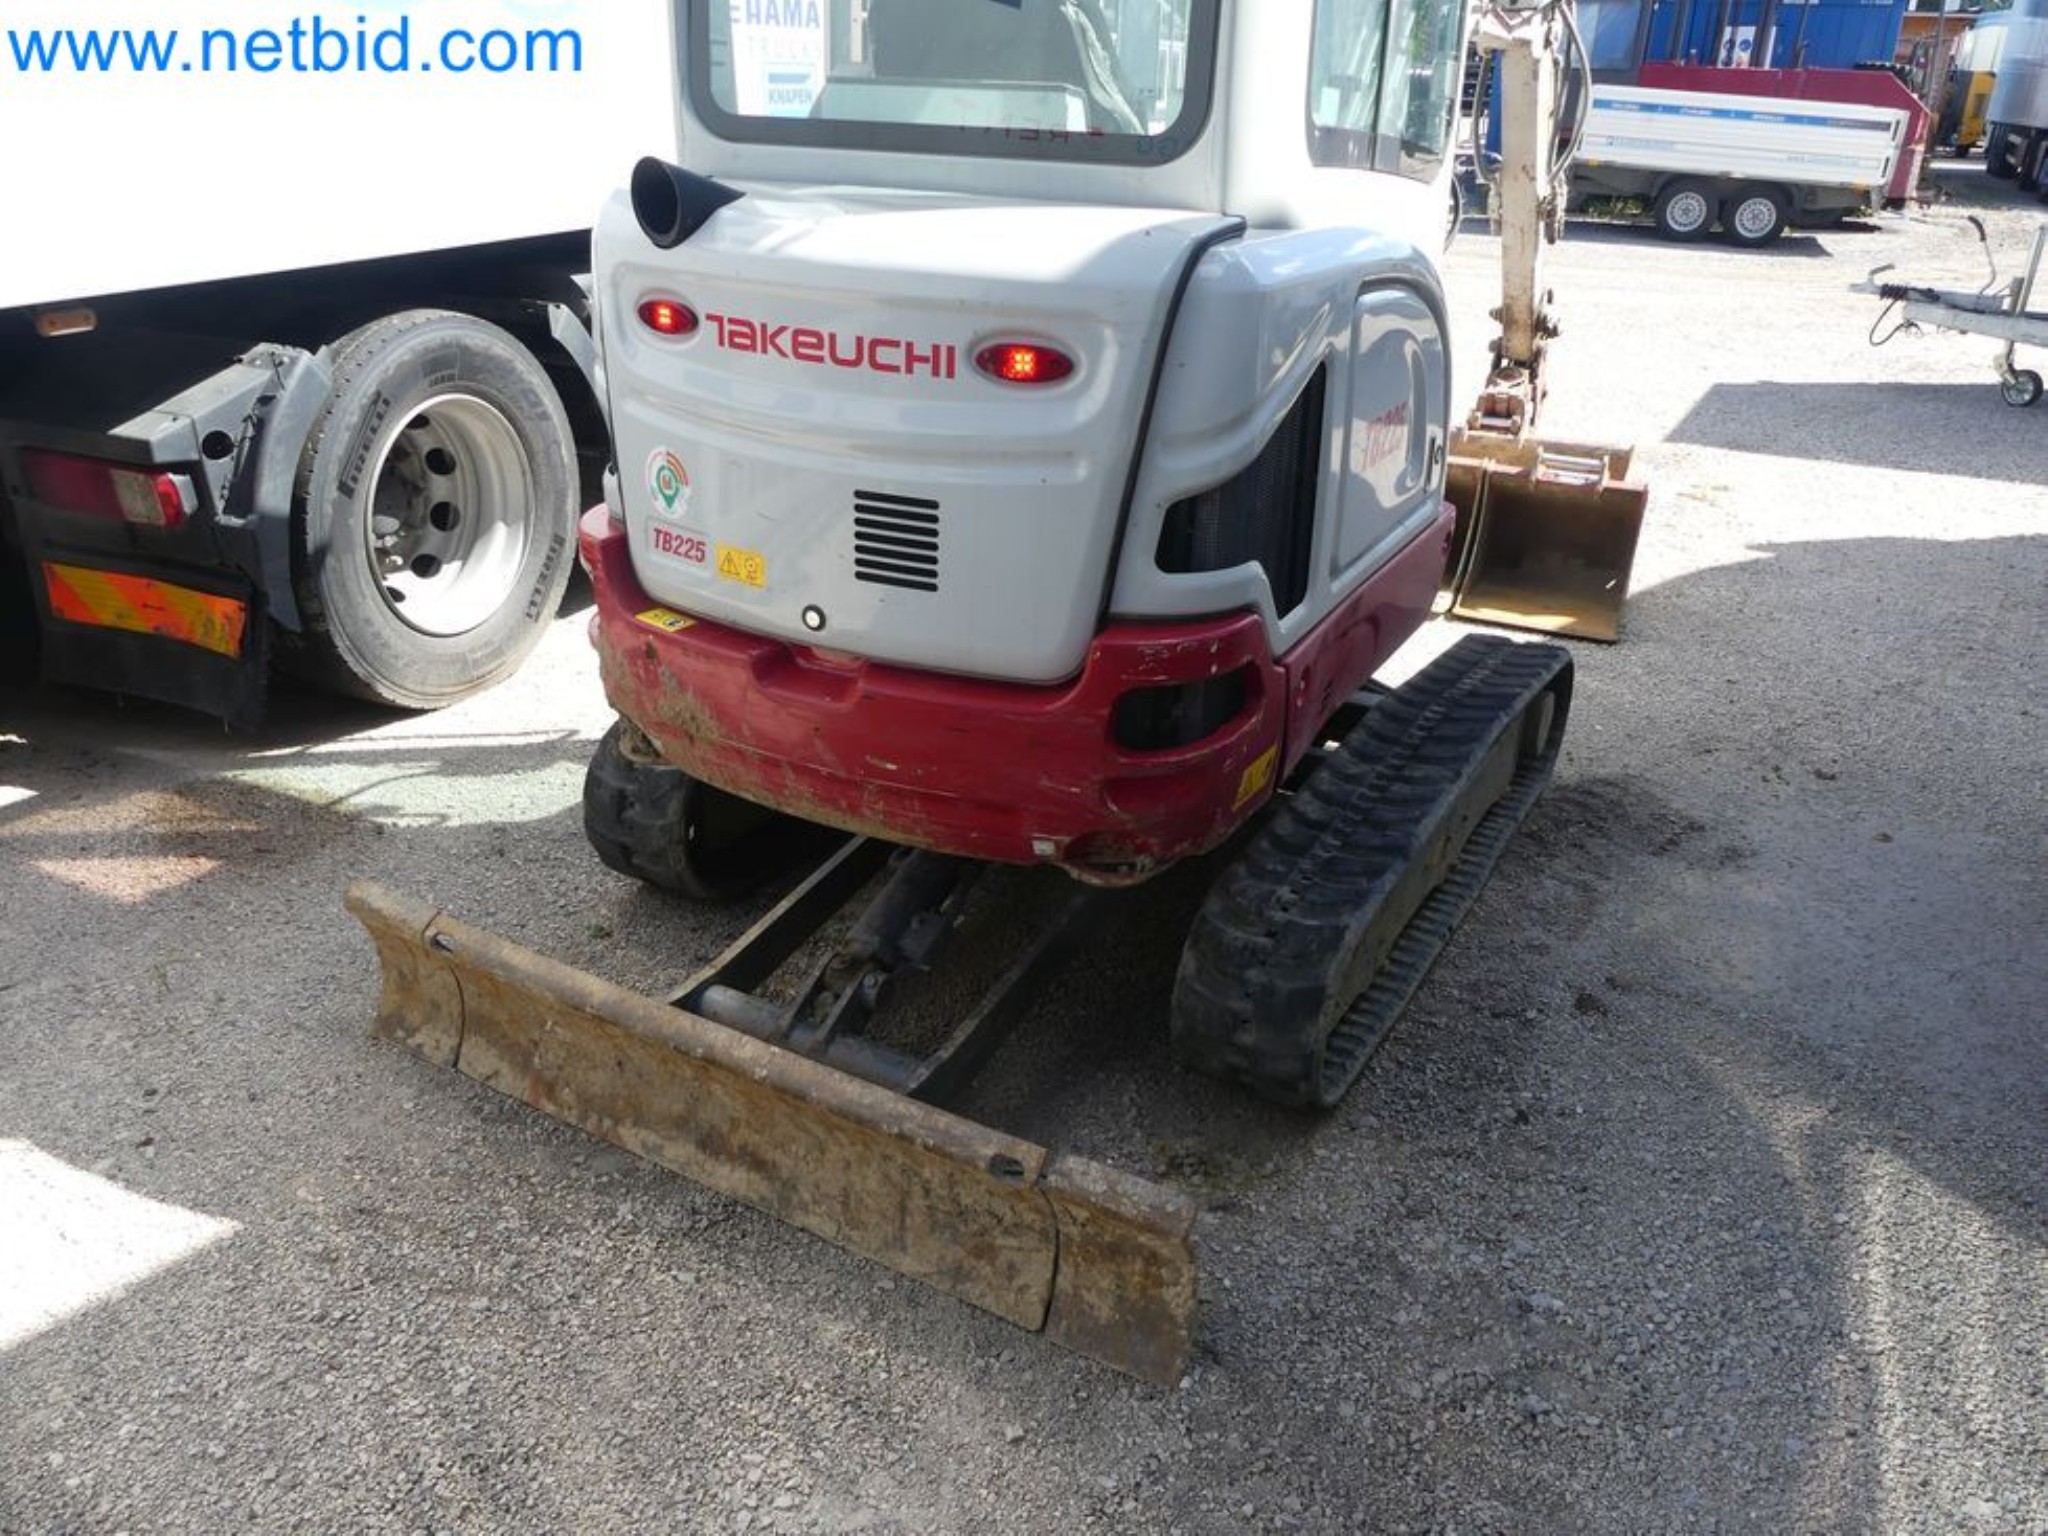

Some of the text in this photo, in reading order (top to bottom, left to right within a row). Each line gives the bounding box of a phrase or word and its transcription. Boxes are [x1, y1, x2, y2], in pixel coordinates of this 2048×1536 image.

[768, 87, 813, 105] KNAPEN
[705, 312, 957, 379] TAKEUCHI
[653, 528, 707, 563] TB225
